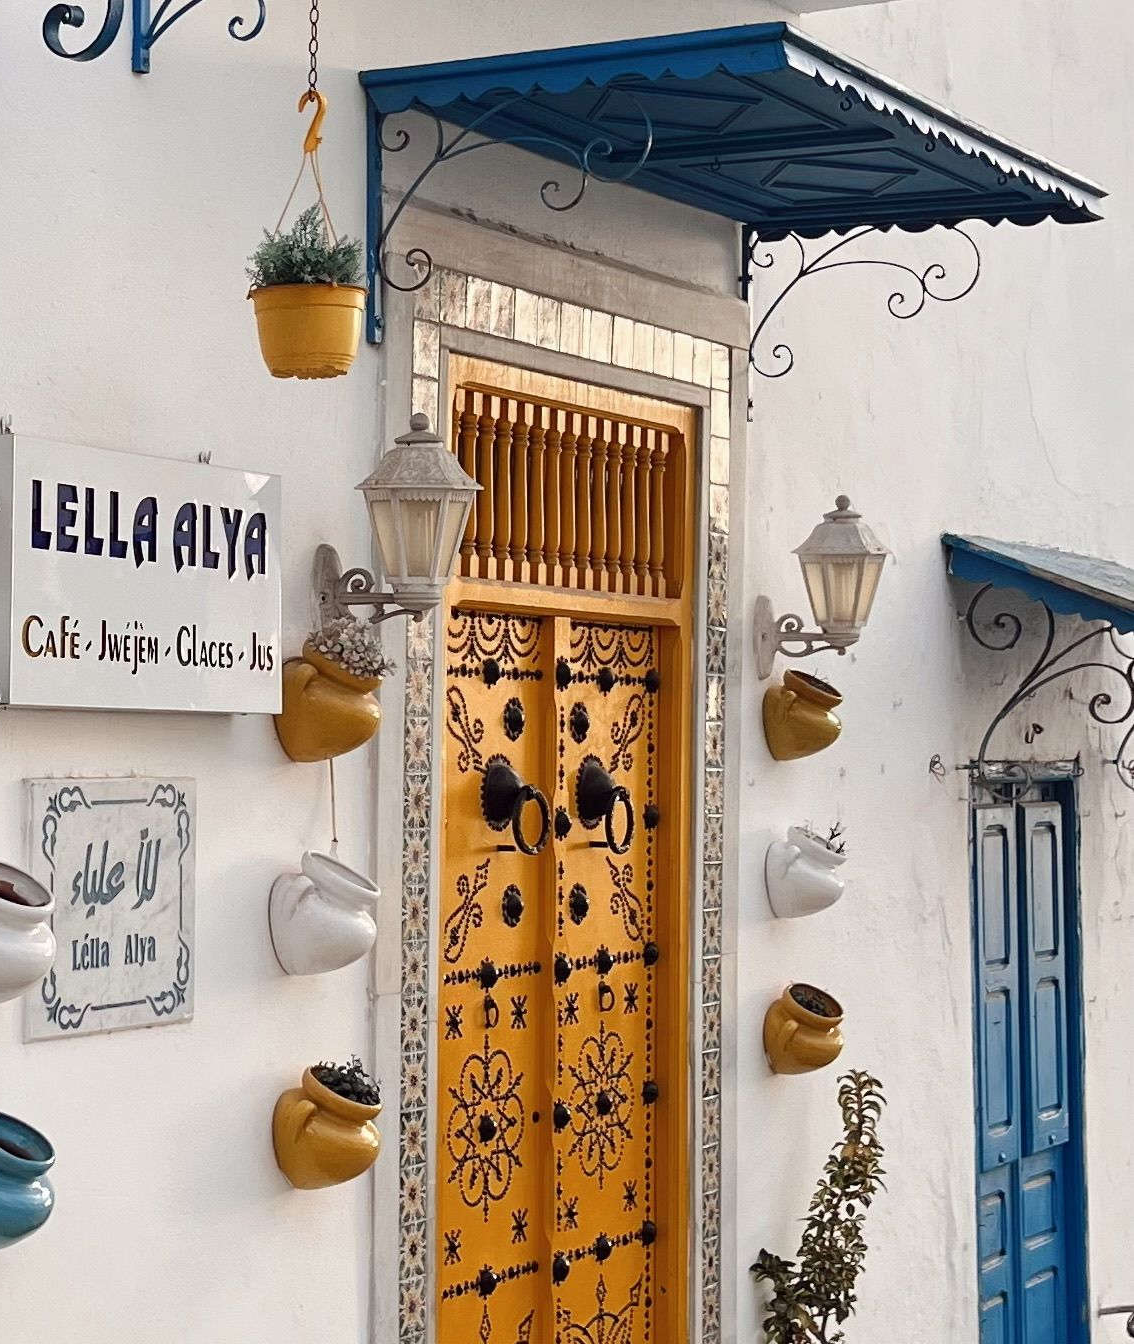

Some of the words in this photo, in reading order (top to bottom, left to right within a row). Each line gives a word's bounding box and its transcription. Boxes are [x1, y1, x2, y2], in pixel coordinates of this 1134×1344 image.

[31, 479, 158, 569] LELLA
[172, 502, 267, 582] ALYA
[21, 614, 81, 660] Café
[176, 624, 234, 669] Glaces
[249, 631, 274, 671] Jus
[70, 839, 126, 919] علياء
[71, 932, 110, 972] Lélla
[124, 932, 157, 968] Alya
